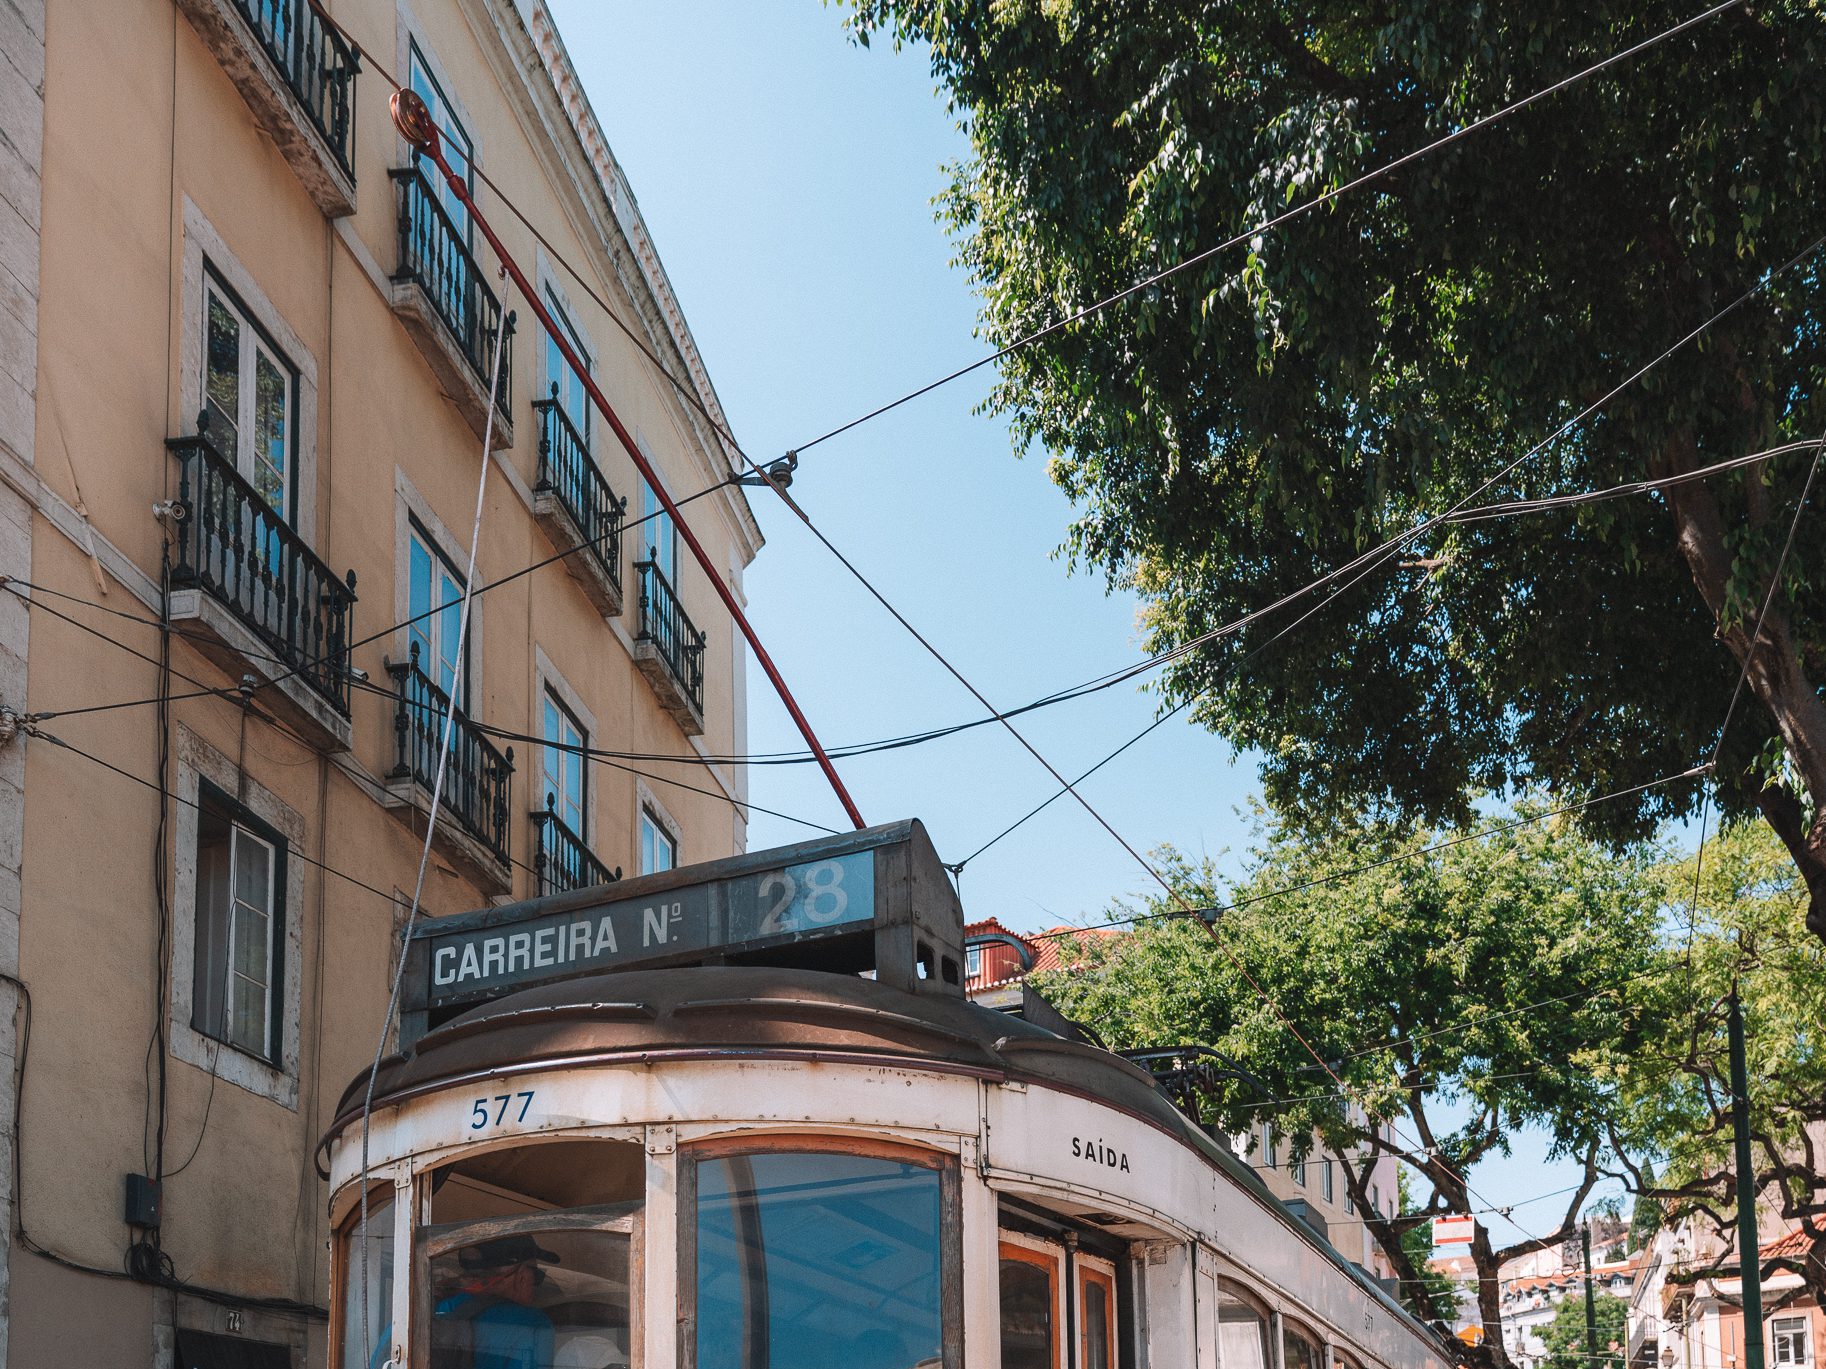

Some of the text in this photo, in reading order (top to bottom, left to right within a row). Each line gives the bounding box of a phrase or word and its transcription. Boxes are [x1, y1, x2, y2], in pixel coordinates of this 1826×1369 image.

[434, 916, 618, 986] CARREIRA
[758, 859, 848, 935] 28
[471, 1090, 535, 1130] 577
[1072, 1136, 1130, 1174] SAÍDA
